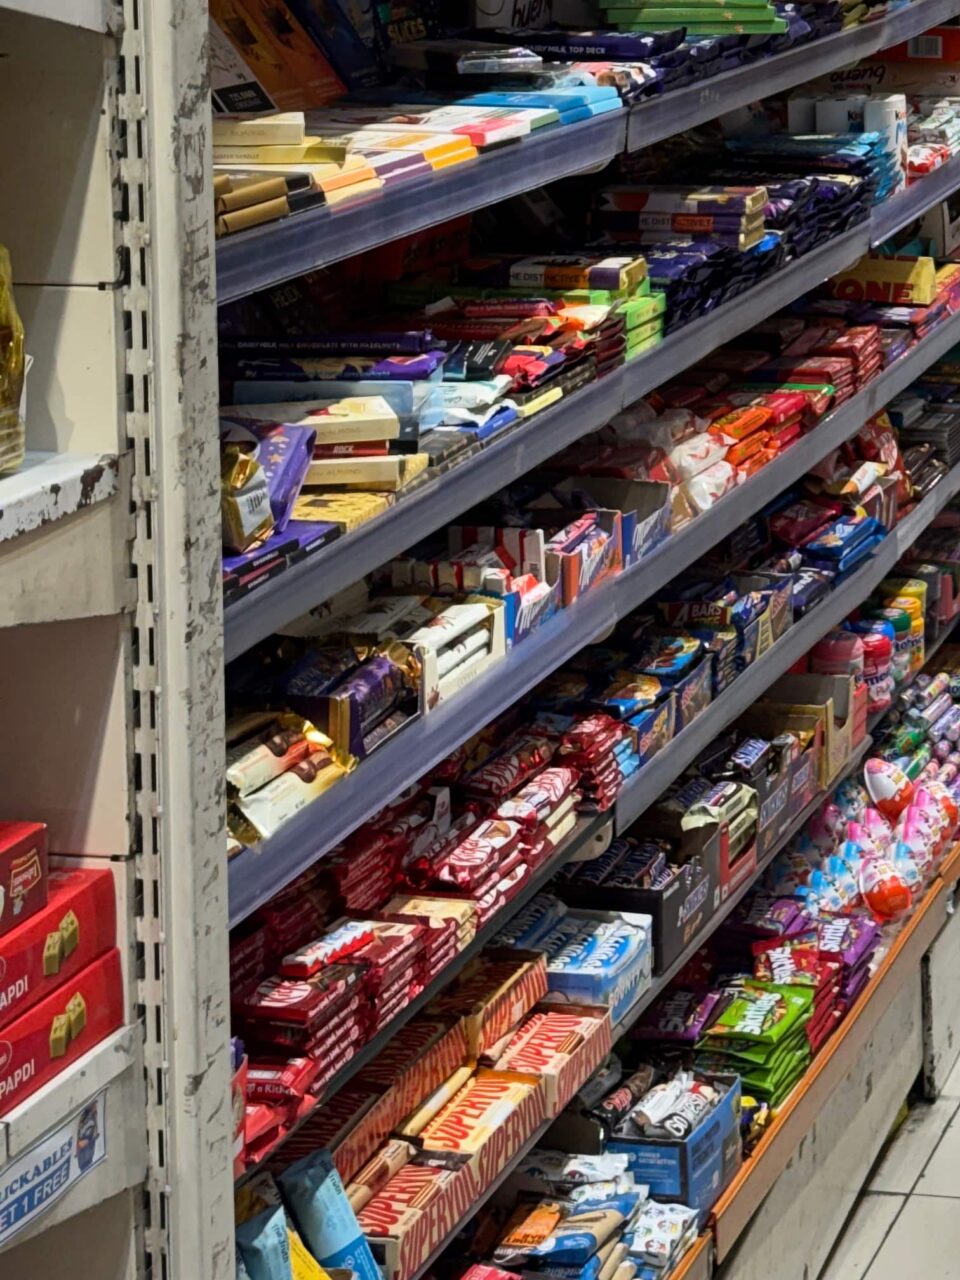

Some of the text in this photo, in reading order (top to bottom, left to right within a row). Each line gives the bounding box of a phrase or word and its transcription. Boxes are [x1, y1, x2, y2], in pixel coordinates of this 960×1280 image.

[510, 272, 521, 283] HE
[834, 278, 914, 304] ONE
[332, 444, 354, 454] ROCK
[690, 603, 723, 618] BARS
[582, 933, 627, 970] BOUNTY
[0, 1058, 36, 1101] PAPDI
[0, 1135, 73, 1202] ICKABLES
[21, 1195, 29, 1214] 1
[33, 1162, 70, 1207] FREE
[278, 1236, 289, 1265] Truth
